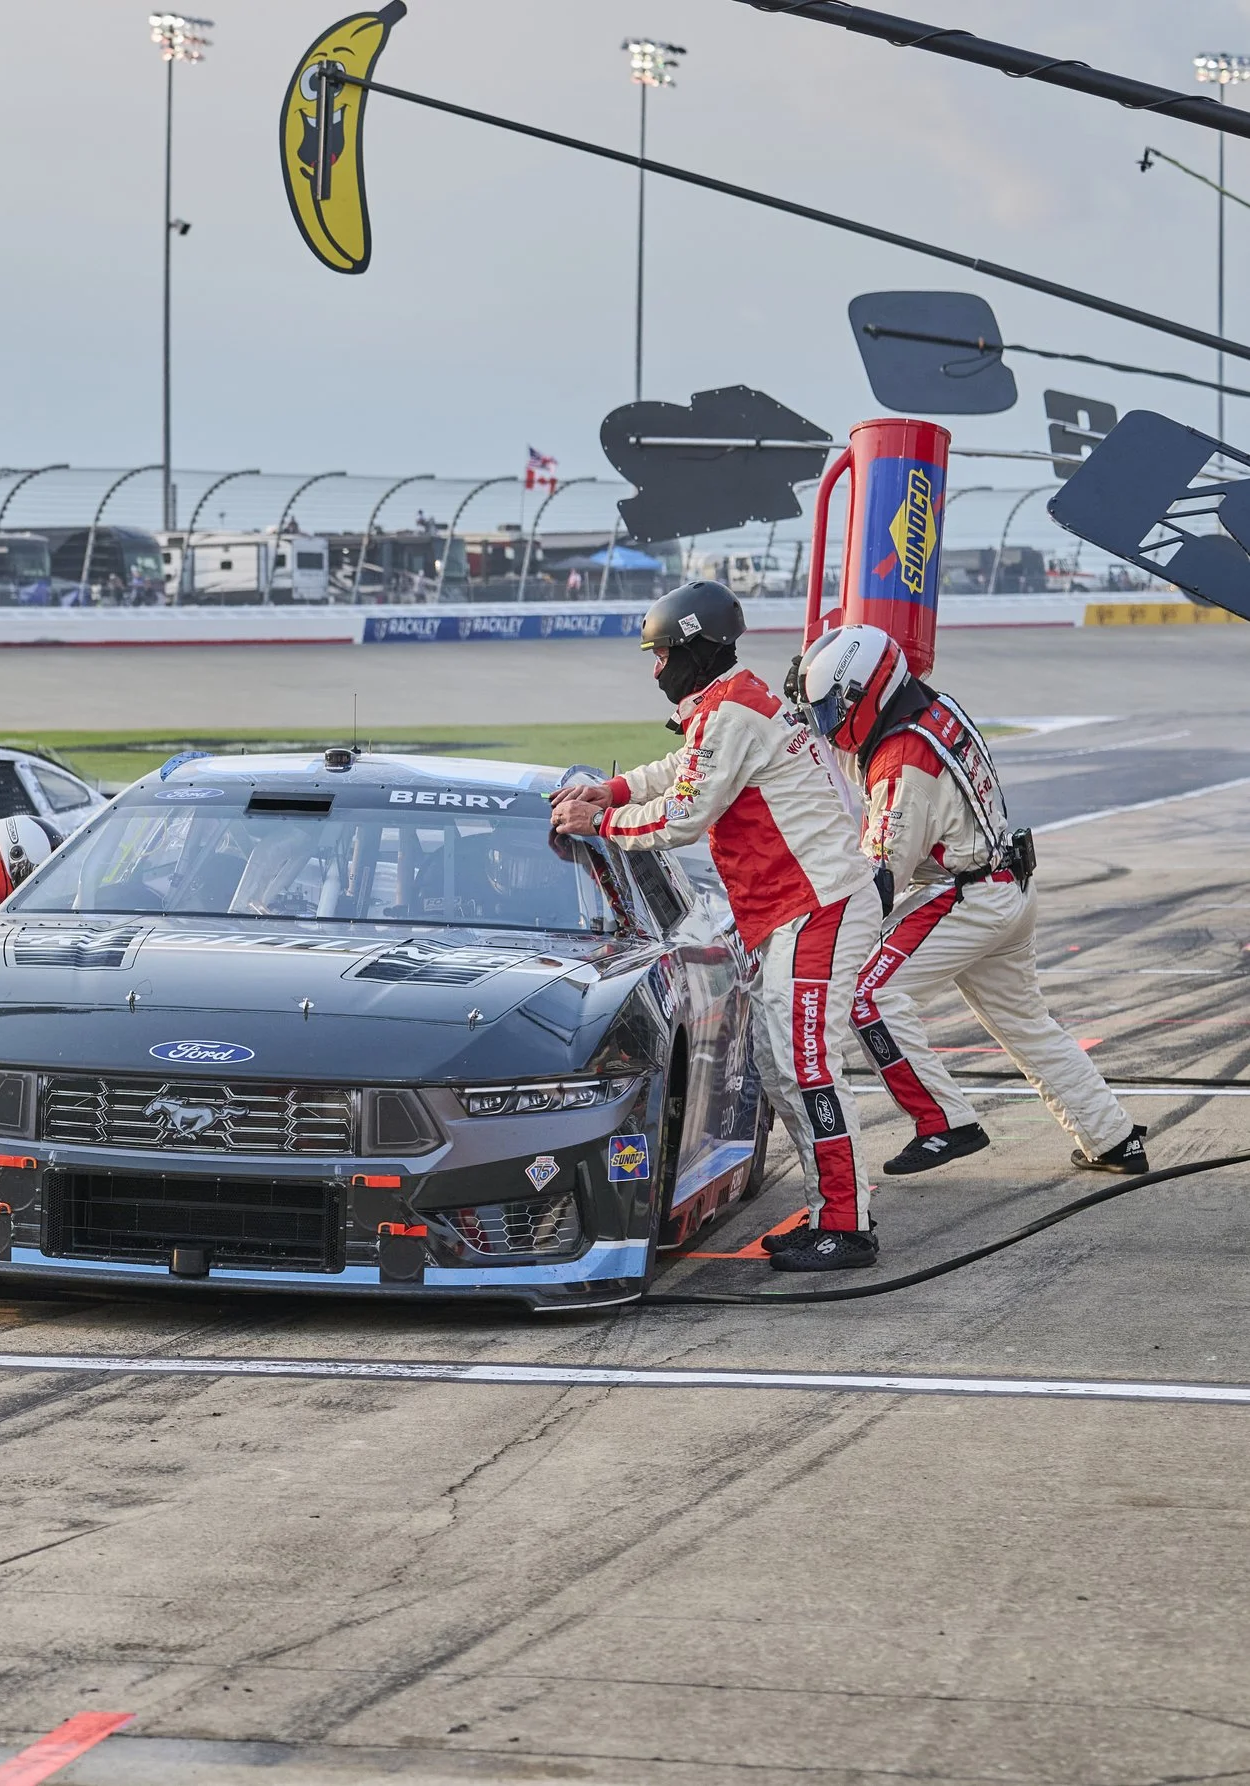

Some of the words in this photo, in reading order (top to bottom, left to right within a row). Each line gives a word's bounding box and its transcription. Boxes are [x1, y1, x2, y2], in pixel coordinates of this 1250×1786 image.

[904, 473, 929, 590] SUNOCO
[389, 618, 441, 634] RACKLEY
[473, 617, 524, 633] RACKLEY
[554, 616, 606, 631] RACKLEY
[836, 643, 857, 679] FREIGHTLINER
[389, 790, 517, 810] BERRY
[801, 989, 822, 1083] Motorcraft
[168, 1042, 236, 1061] Ford
[818, 1099, 834, 1124] Ford
[612, 1153, 643, 1165] SUNOCO
[534, 1165, 551, 1181] 75
